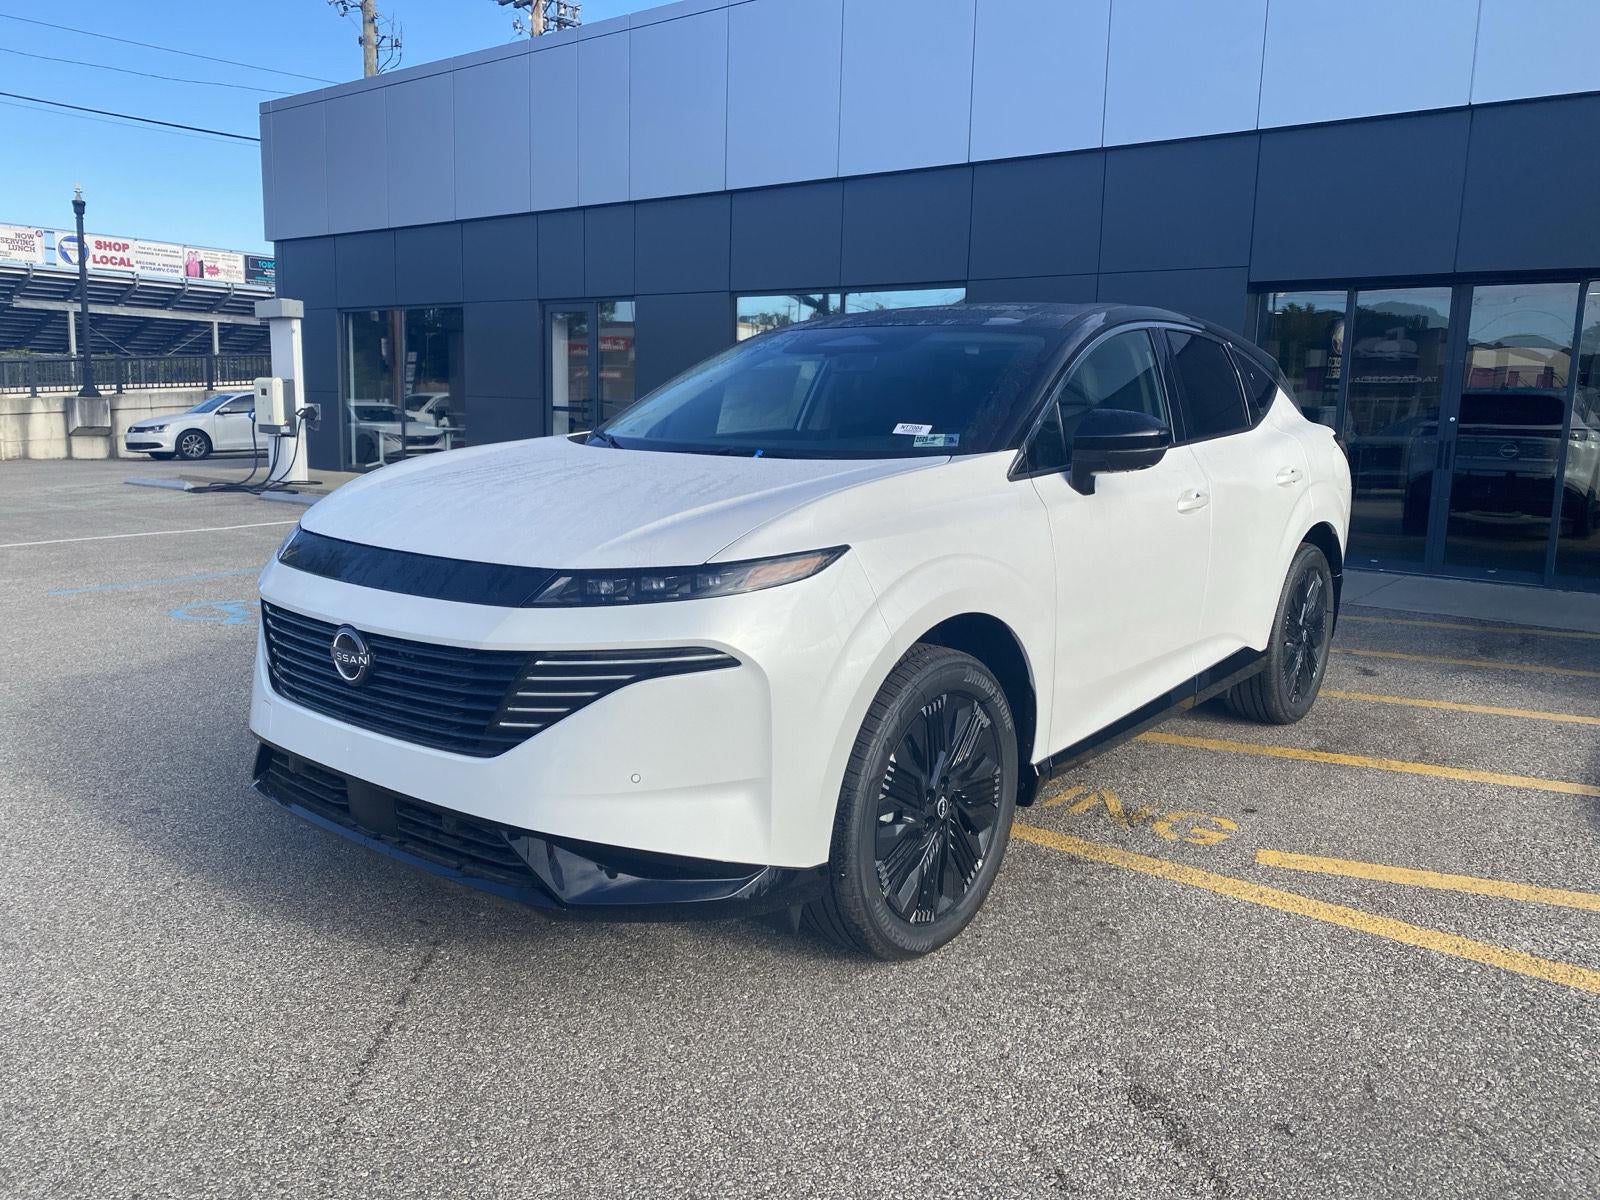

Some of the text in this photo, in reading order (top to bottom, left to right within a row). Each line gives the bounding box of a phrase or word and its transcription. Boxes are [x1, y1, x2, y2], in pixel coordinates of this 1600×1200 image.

[15, 232, 34, 240] NOW
[0, 237, 35, 247] SERVING
[94, 240, 130, 252] SHOP
[8, 245, 36, 253] LUNCH
[92, 254, 134, 268] LOCAL
[963, 667, 1012, 731] BRIDGESTONE
